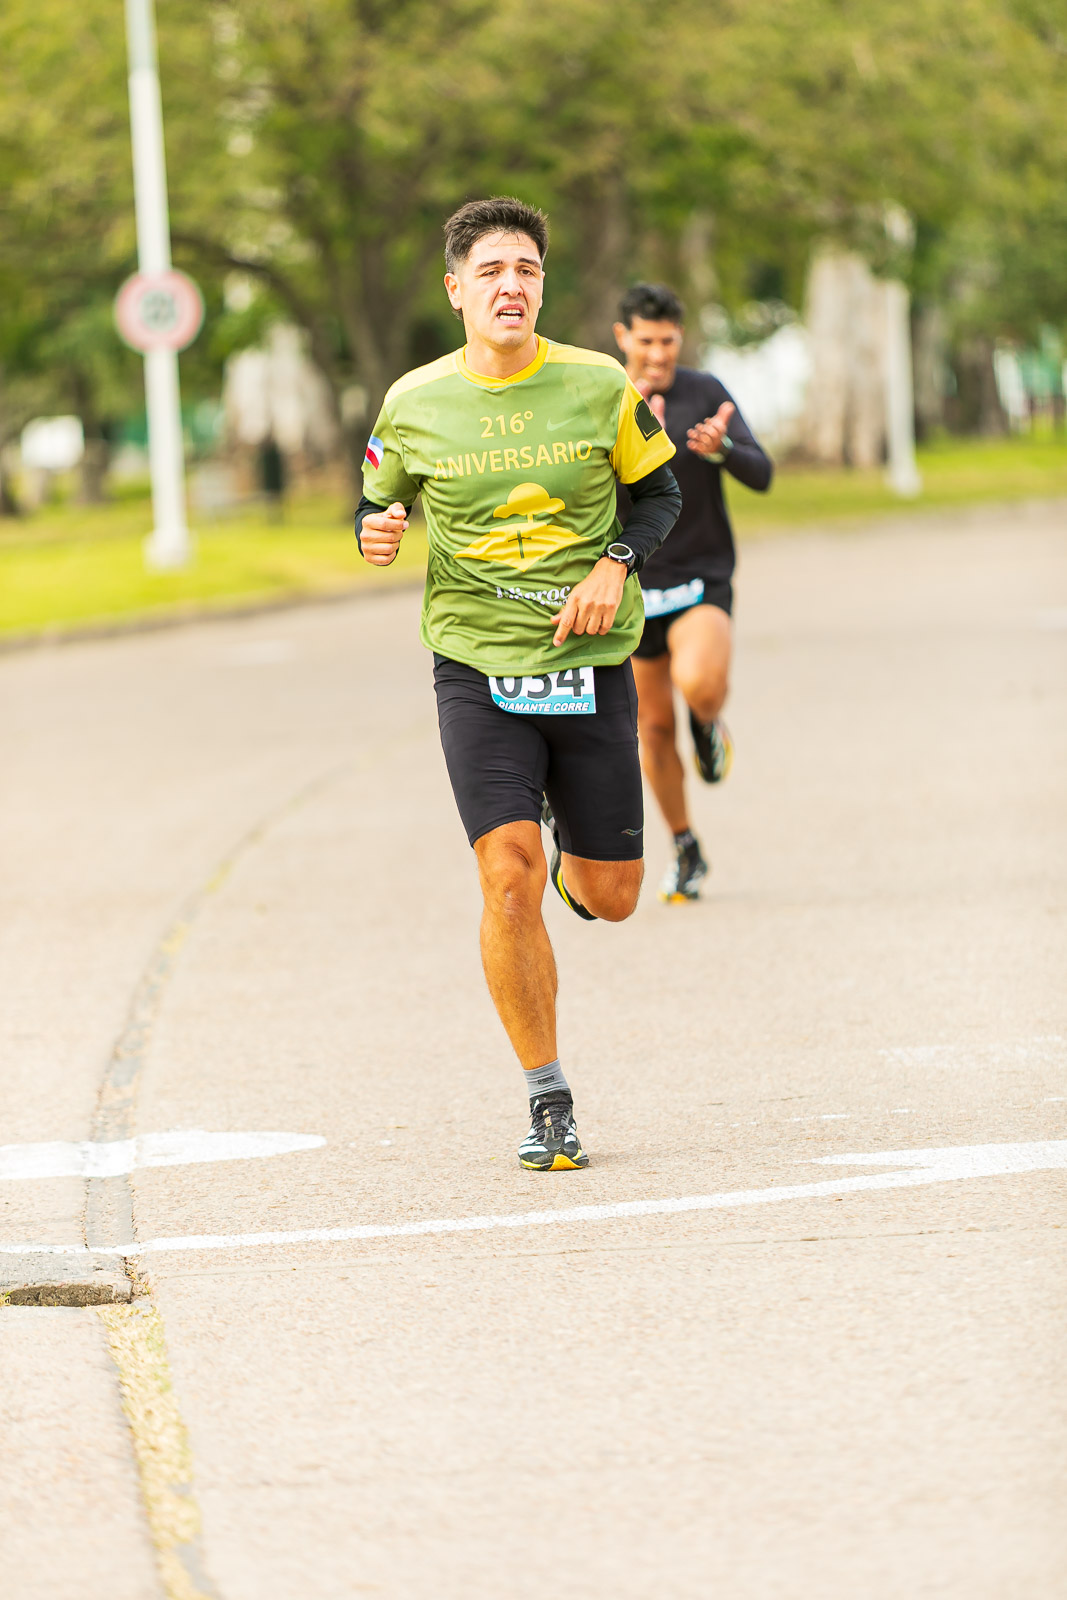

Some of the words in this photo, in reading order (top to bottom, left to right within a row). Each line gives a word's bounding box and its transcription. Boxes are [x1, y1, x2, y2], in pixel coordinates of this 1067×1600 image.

[480, 411, 533, 438] 216°
[434, 440, 592, 480] ANIVERSARIO
[498, 701, 551, 712] DIAMANTE
[553, 702, 590, 712] CORRE
